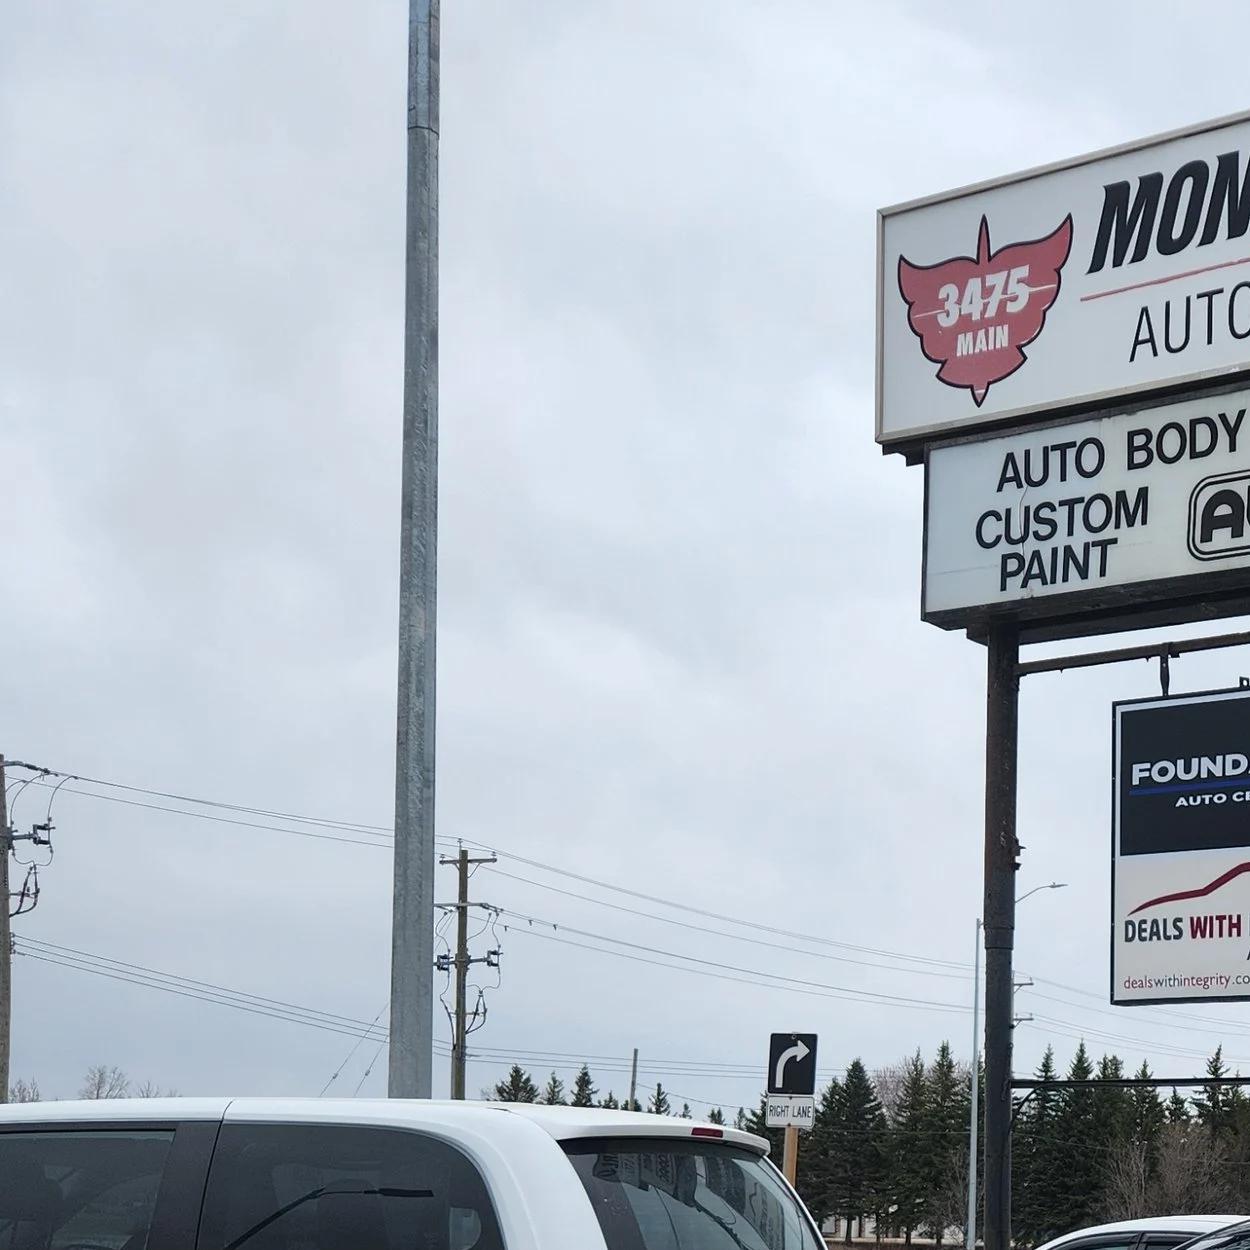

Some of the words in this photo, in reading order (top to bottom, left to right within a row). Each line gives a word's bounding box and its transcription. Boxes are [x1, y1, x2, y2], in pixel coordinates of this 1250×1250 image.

[936, 265, 1030, 328] 3475
[955, 323, 1010, 358] MAIN
[996, 438, 1106, 493] AUTO
[1126, 408, 1247, 471] BODY
[976, 487, 1149, 549] CUSTOM
[1000, 538, 1119, 593] PAINT
[1175, 792, 1227, 808] AUTO
[1124, 916, 1184, 943] DEALS
[1189, 914, 1242, 940] WITH
[768, 1104, 790, 1117] RIGHT
[791, 1105, 812, 1118] LANE
